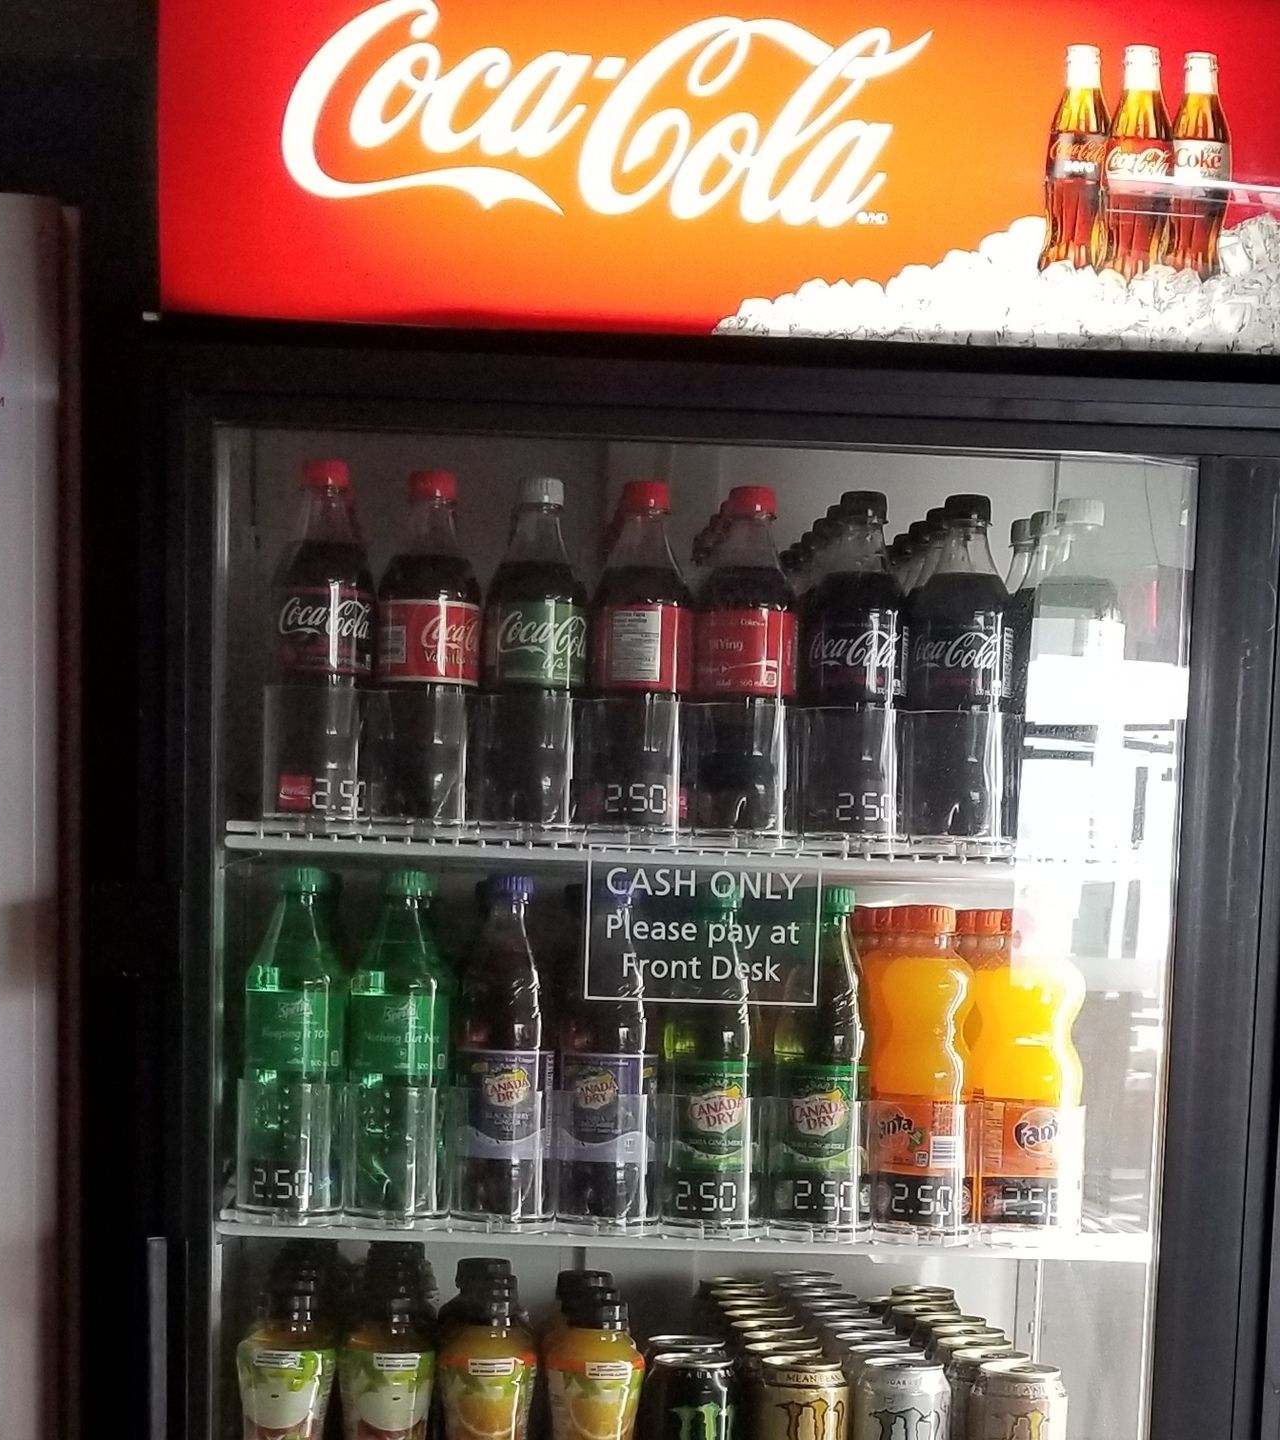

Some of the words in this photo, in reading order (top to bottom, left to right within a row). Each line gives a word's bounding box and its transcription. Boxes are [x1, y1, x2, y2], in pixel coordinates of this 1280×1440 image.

[282, 0, 933, 229] Coca-Cola
[1174, 147, 1221, 170] Coke
[280, 597, 370, 639] Coca-Cola
[809, 630, 900, 668] Coca-Cola
[606, 784, 667, 814] 2.50
[606, 867, 696, 897] CASH
[710, 870, 803, 901] ONLY
[606, 914, 696, 940] Please
[708, 922, 760, 948] pay
[770, 924, 799, 945] at
[622, 953, 701, 979] Front
[711, 956, 781, 982] Desk
[485, 1078, 529, 1098] CANADA
[497, 1090, 520, 1102] DRY
[584, 1094, 608, 1104] DRY
[689, 1096, 744, 1121] CANADA
[707, 1115, 734, 1128] DRY
[793, 1100, 848, 1123] CANADA
[806, 1117, 835, 1130] DRY
[253, 1168, 312, 1199] 2.50
[675, 1181, 737, 1212] 2.50
[794, 1180, 856, 1211] 2.50
[892, 1184, 952, 1215] 2.50
[786, 1372, 819, 1385] MEAN
